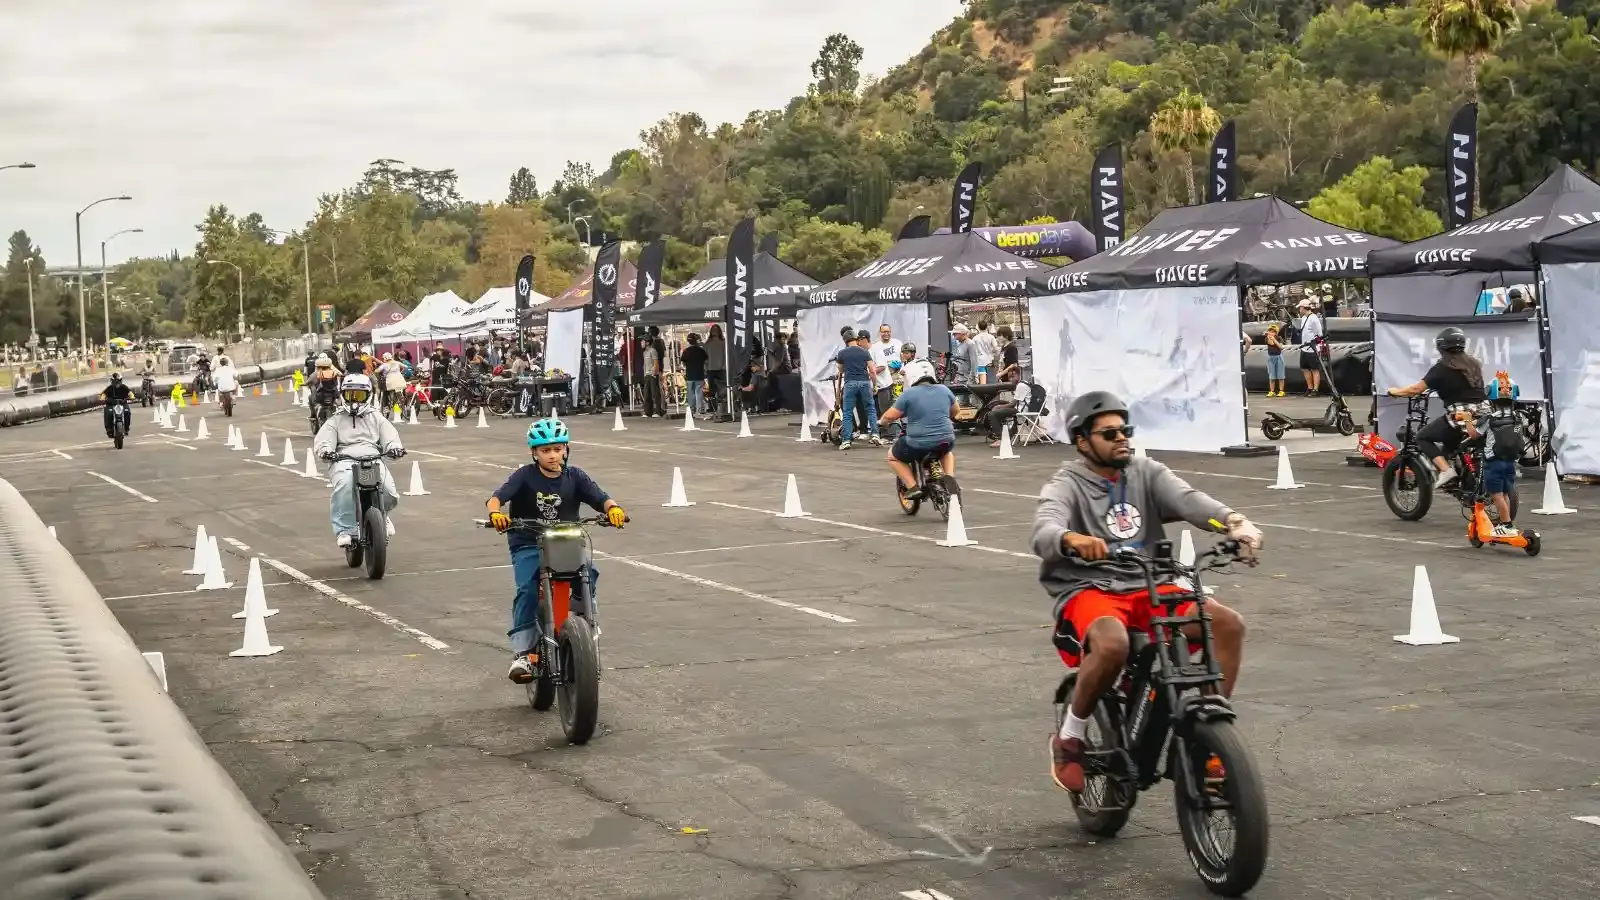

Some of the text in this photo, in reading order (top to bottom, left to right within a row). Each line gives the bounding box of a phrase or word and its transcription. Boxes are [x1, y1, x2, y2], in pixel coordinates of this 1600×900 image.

[1453, 133, 1469, 226] NAV
[959, 182, 974, 233] NAV
[1100, 167, 1119, 249] NAVE
[1448, 216, 1544, 236] NAVEE
[997, 227, 1072, 247] demodays
[1109, 228, 1240, 256] NAVEE
[1260, 233, 1369, 249] NAVEE
[1014, 247, 1061, 257] ESTIVAL
[1415, 248, 1477, 264] NAVEE
[855, 255, 944, 279] NAVEE
[953, 260, 1038, 273] NAVEE
[1155, 264, 1209, 283] NAVEE
[1306, 256, 1369, 272] NAVE
[1047, 271, 1090, 290] NAVEE
[753, 284, 820, 297] ANTI
[809, 289, 839, 304] NAVEE
[879, 286, 913, 300] NAVEE
[735, 256, 747, 348] ANTIC
